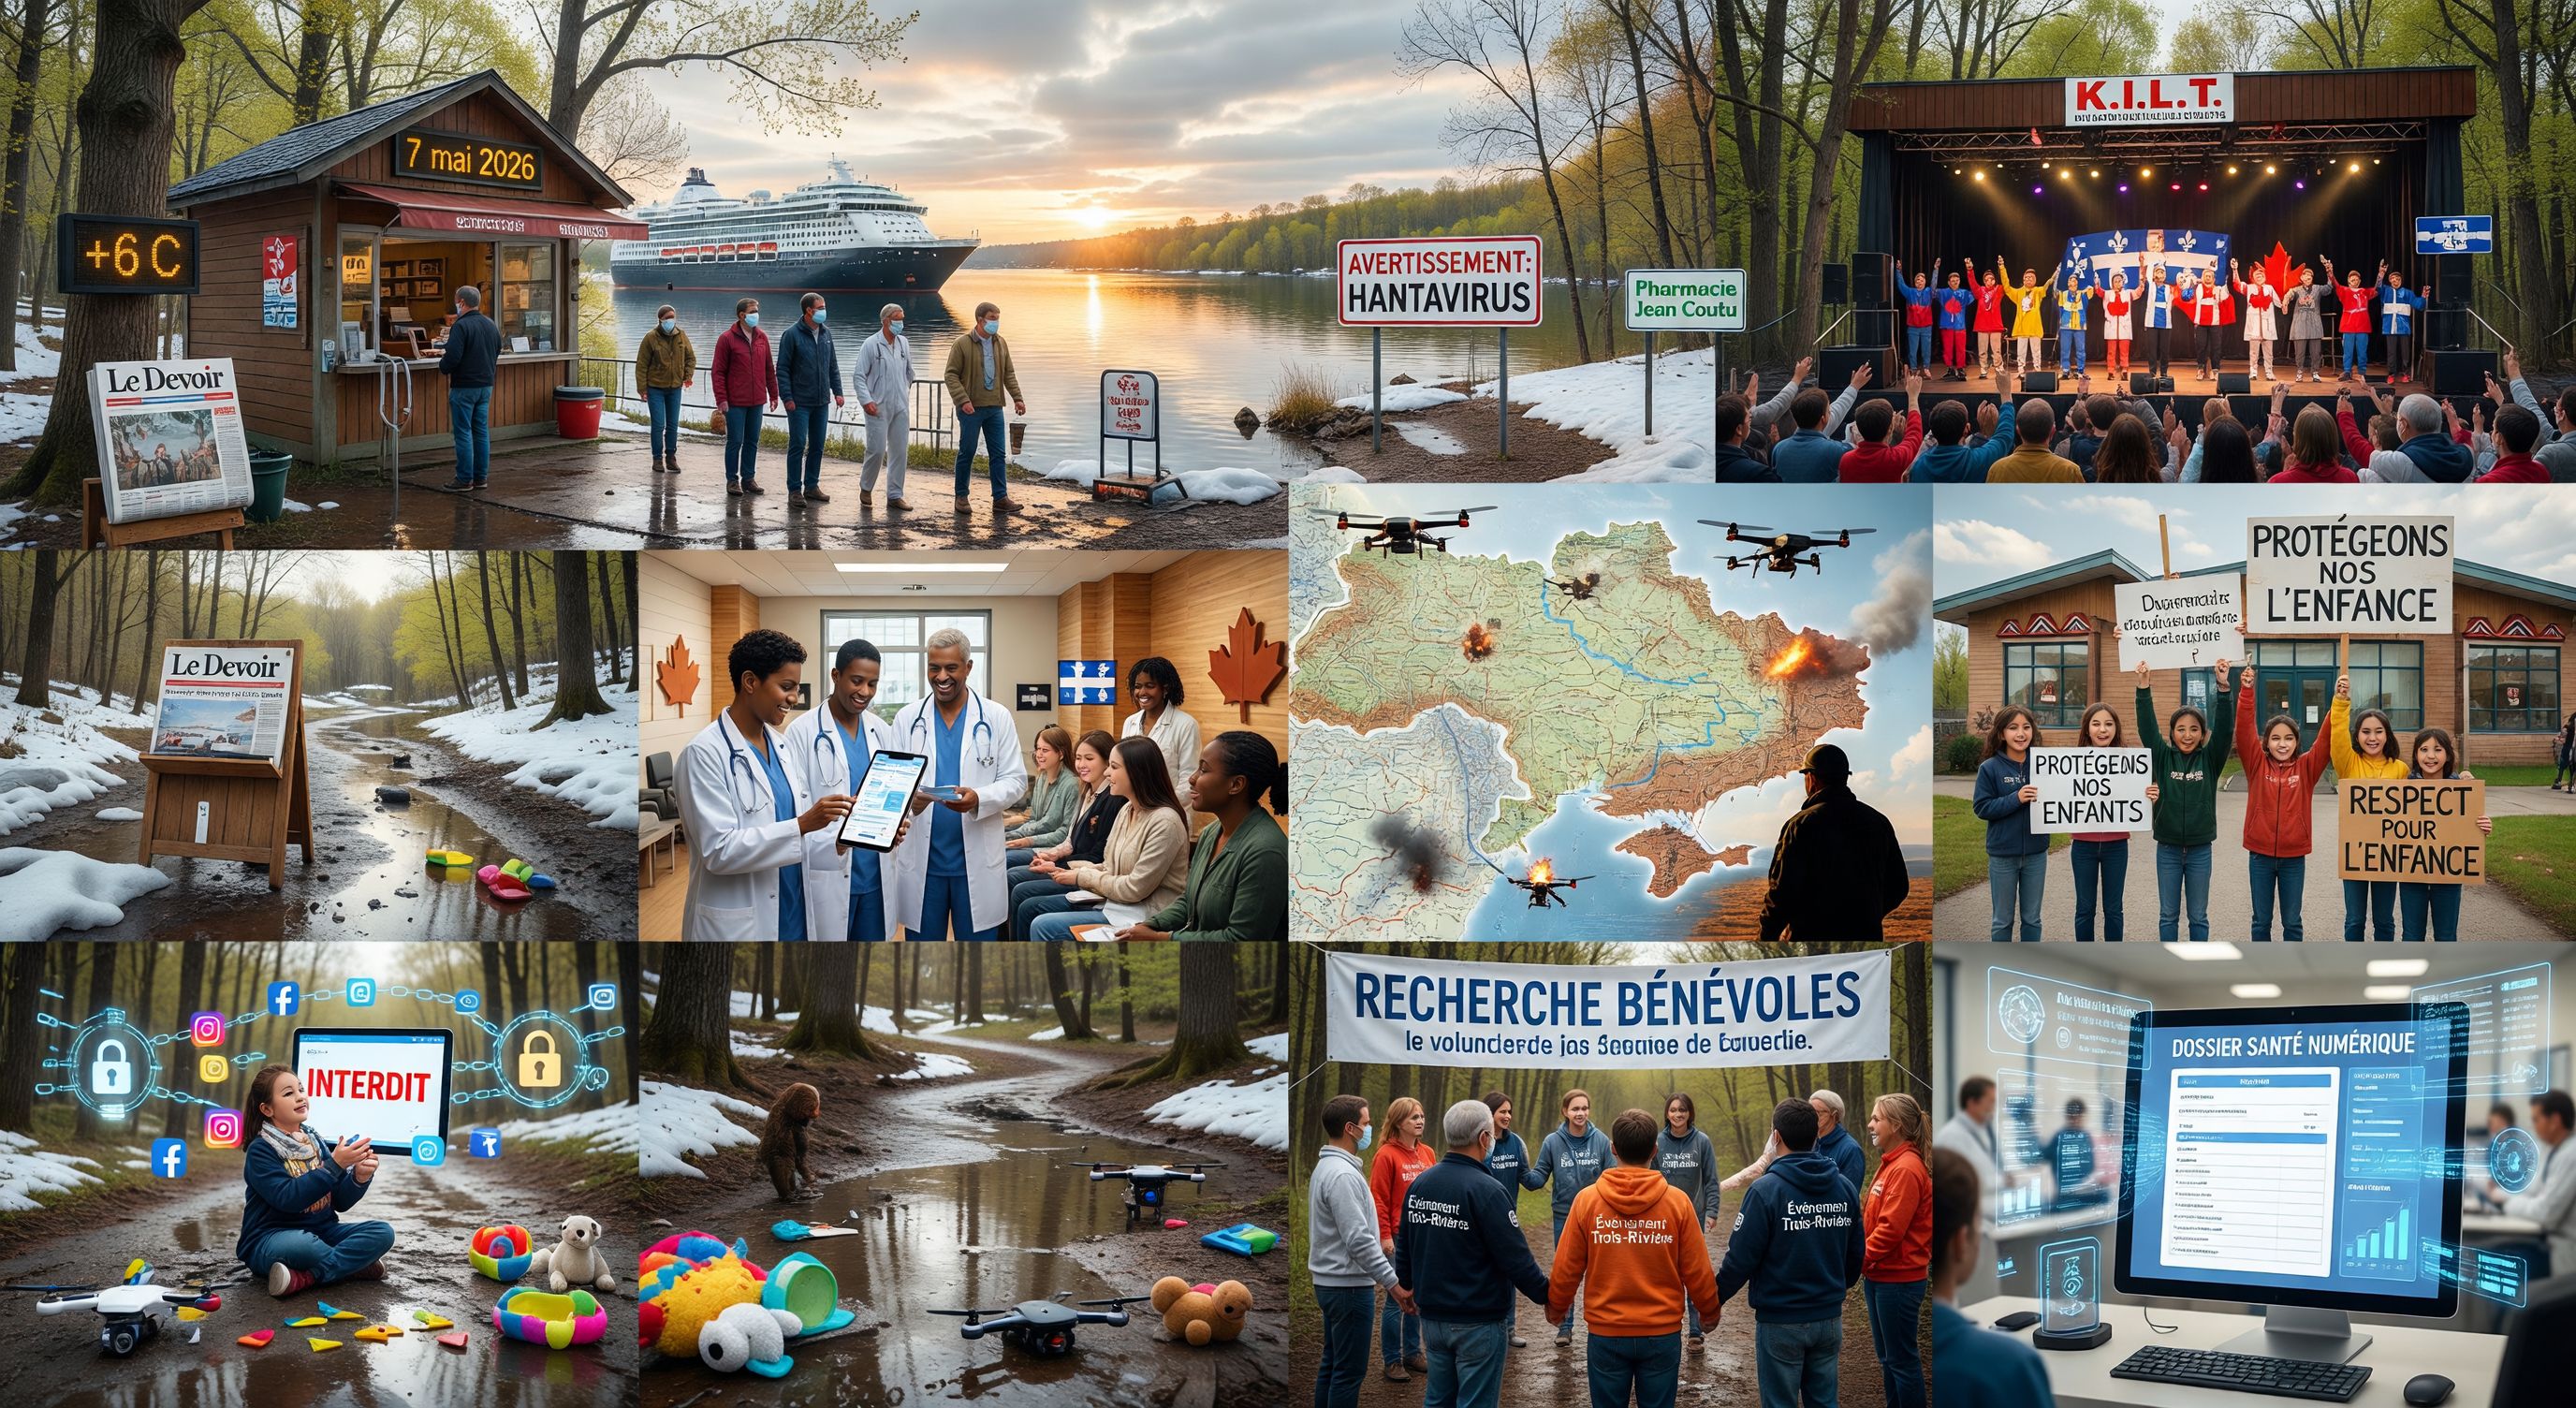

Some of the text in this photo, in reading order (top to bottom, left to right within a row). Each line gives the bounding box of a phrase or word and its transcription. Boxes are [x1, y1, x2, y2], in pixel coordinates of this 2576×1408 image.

[2076, 78, 2222, 110] K.I.L.T.
[406, 138, 535, 181] 7 mai 2026
[86, 232, 182, 278] +6 C
[1348, 249, 1531, 275] AVERTISSEMENT:
[1348, 282, 1531, 314] HANTAVIRUS
[1634, 279, 1737, 297] Pharmacie
[1634, 301, 1738, 318] Jean Coutu
[106, 365, 224, 393] Le Devoir
[2253, 513, 2449, 558] PROTÉGEONS
[2320, 561, 2377, 585] NOS
[2267, 587, 2437, 623] L'ENFANCE
[170, 653, 281, 678] Le Devoir
[2072, 778, 2112, 797] NOS
[2349, 785, 2473, 816] RESPECT
[2042, 799, 2144, 825] ENFANTS
[2381, 818, 2437, 840] POUR
[2345, 842, 2481, 876] L'ENFANCE
[1355, 966, 1862, 1027] RECHERCHE BÉNÉVOLES
[1406, 1030, 1424, 1052] le
[1686, 1033, 1712, 1055] de
[2172, 1029, 2417, 1058] DOSSIER SANTÉ NUMÉRIQUE
[307, 1068, 432, 1103] INTERDIT
